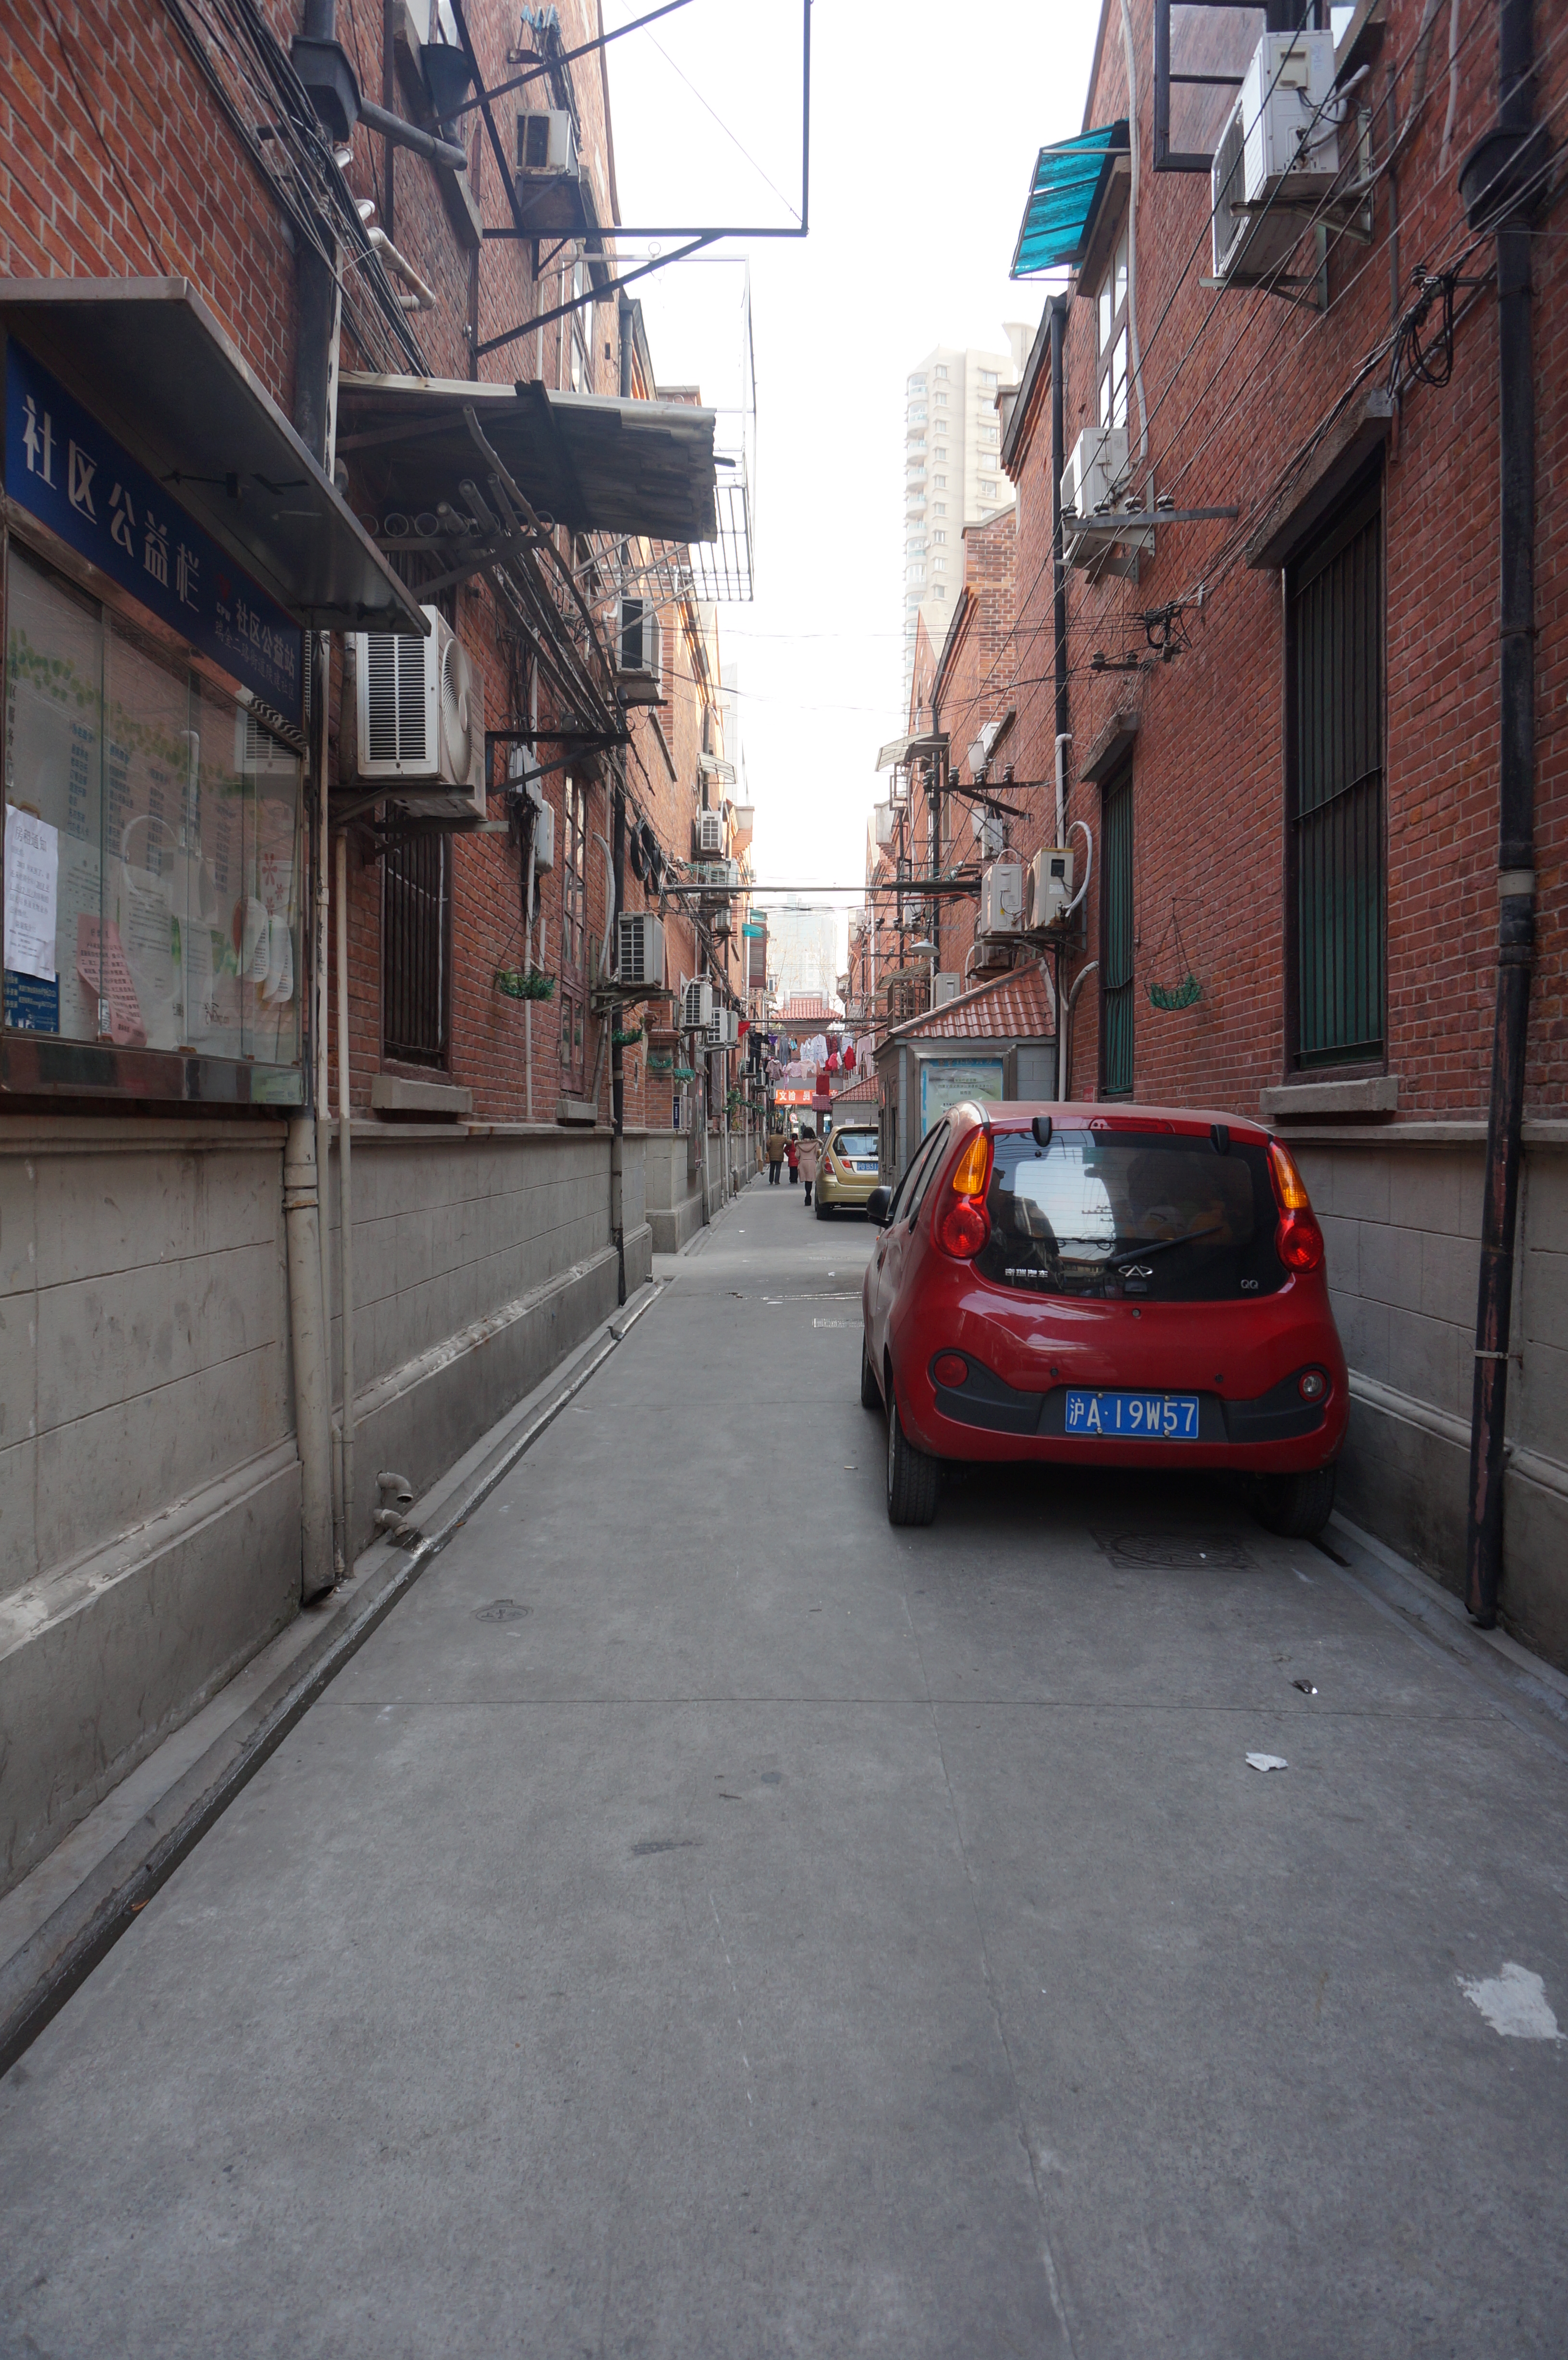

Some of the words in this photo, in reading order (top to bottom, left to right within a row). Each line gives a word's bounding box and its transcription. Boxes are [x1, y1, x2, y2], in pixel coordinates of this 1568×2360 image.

[22, 394, 199, 613] 社区公益栏
[235, 598, 295, 680] 社区公益站
[1005, 1268, 1048, 1278] 奇瑞汽车
[1241, 1279, 1259, 1289] QQ
